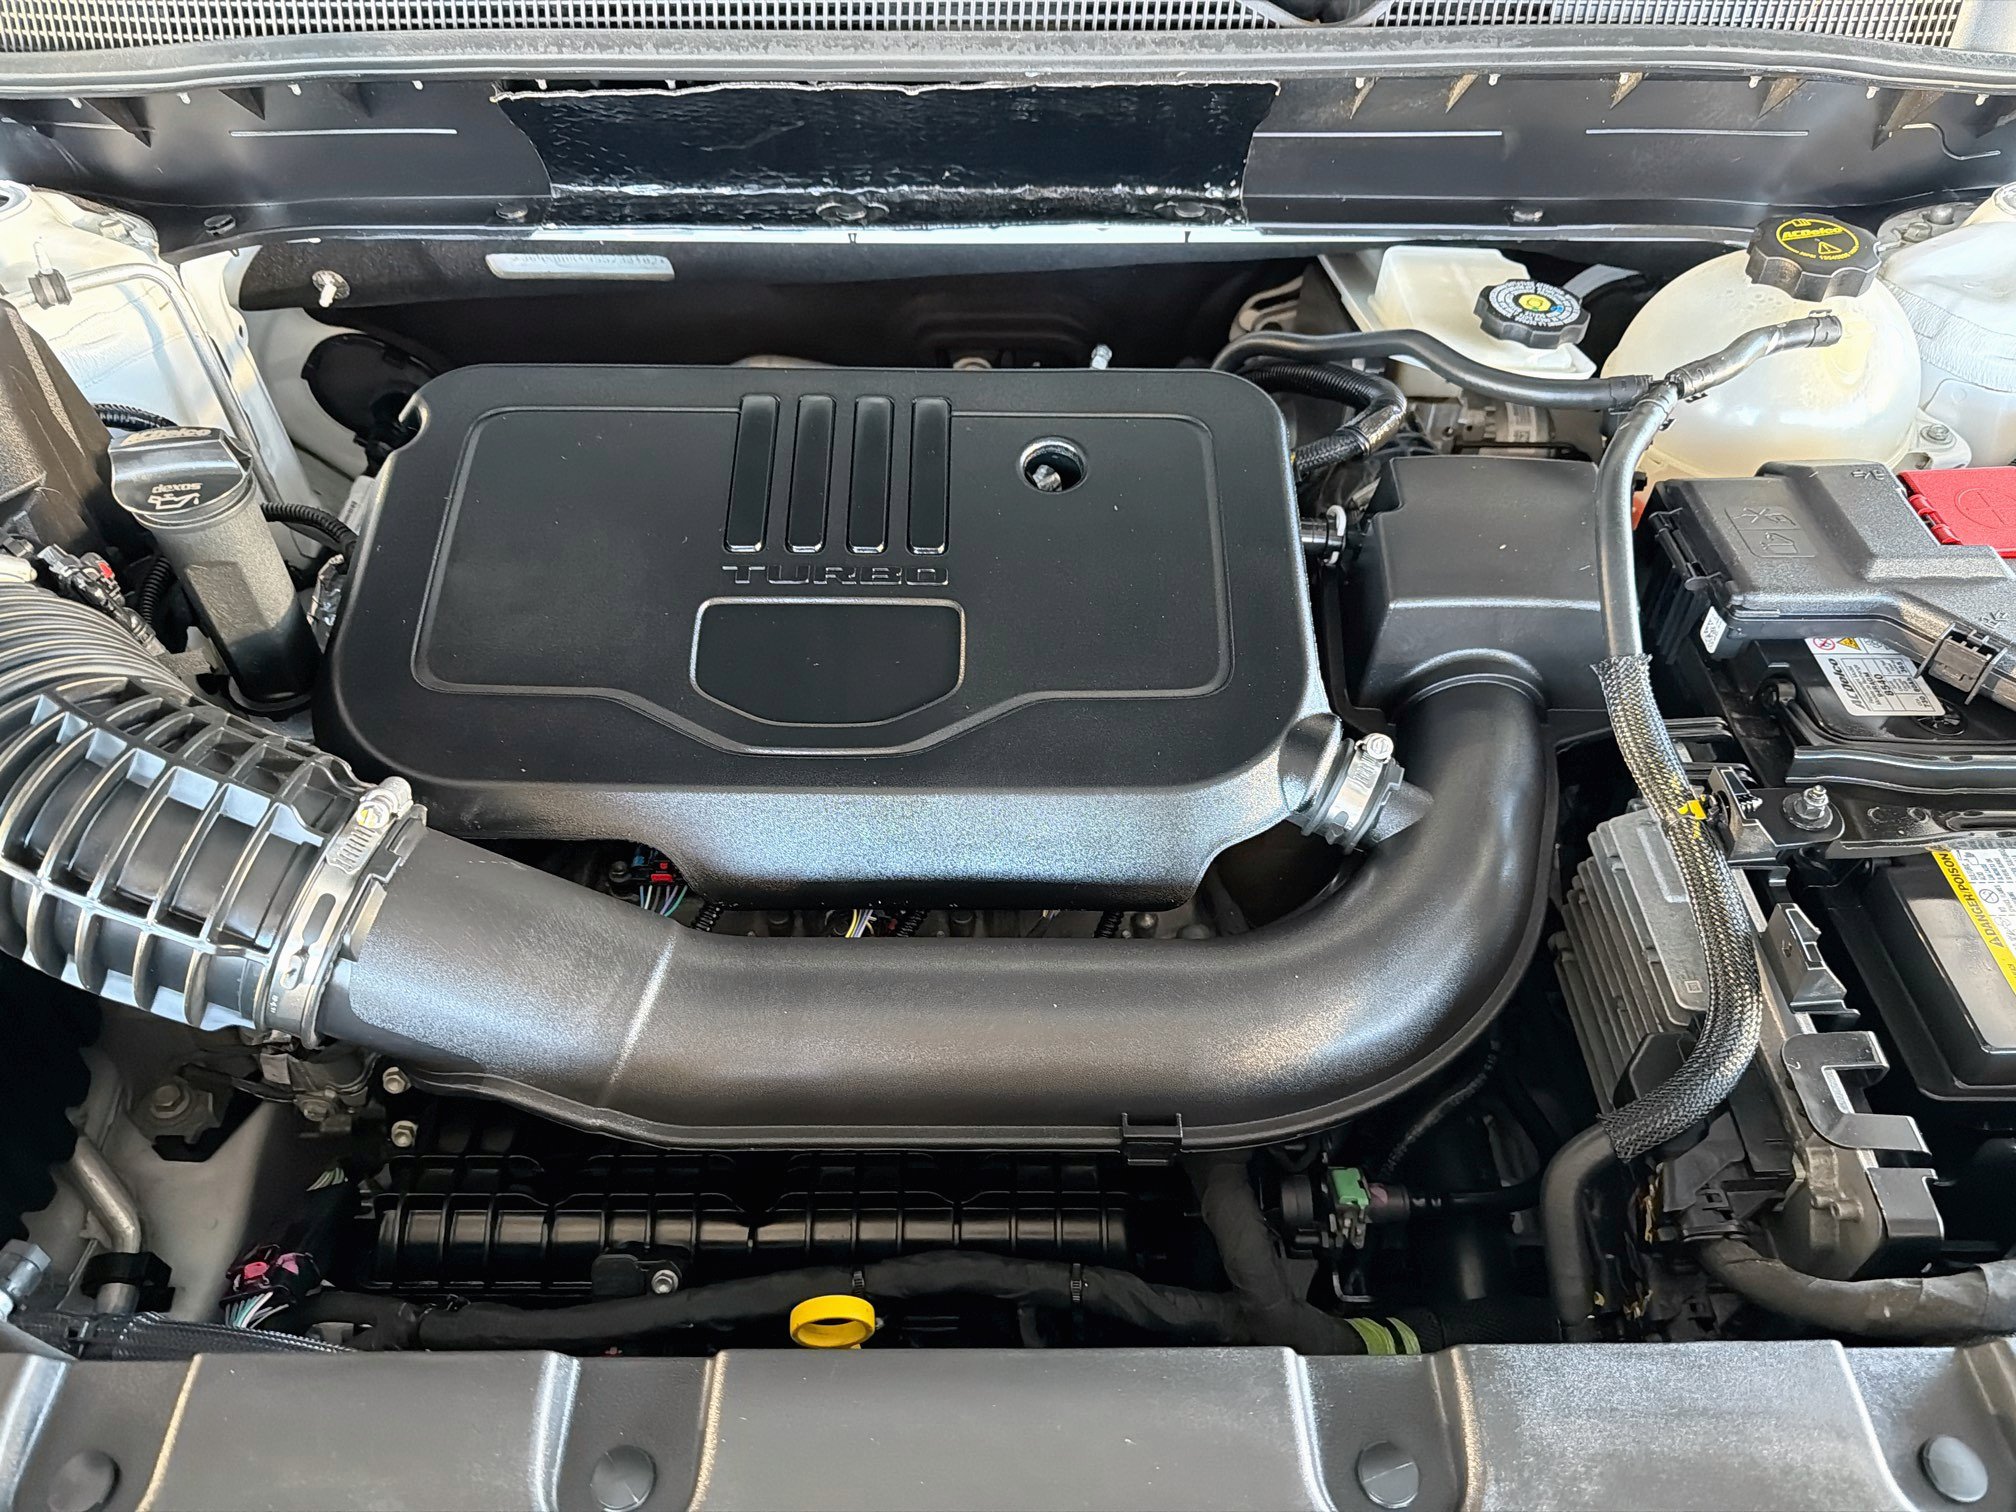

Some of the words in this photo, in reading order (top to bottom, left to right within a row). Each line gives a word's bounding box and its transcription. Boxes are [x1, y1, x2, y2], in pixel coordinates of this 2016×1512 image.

[1782, 227, 1843, 240] ACDelco
[152, 482, 203, 494] dexos
[722, 565, 949, 585] TURBO
[1828, 658, 1866, 709] ACDelco
[1874, 674, 1894, 696] 8540
[1918, 696, 1931, 707] 730
[1937, 853, 1997, 935] DANGER/POISON
